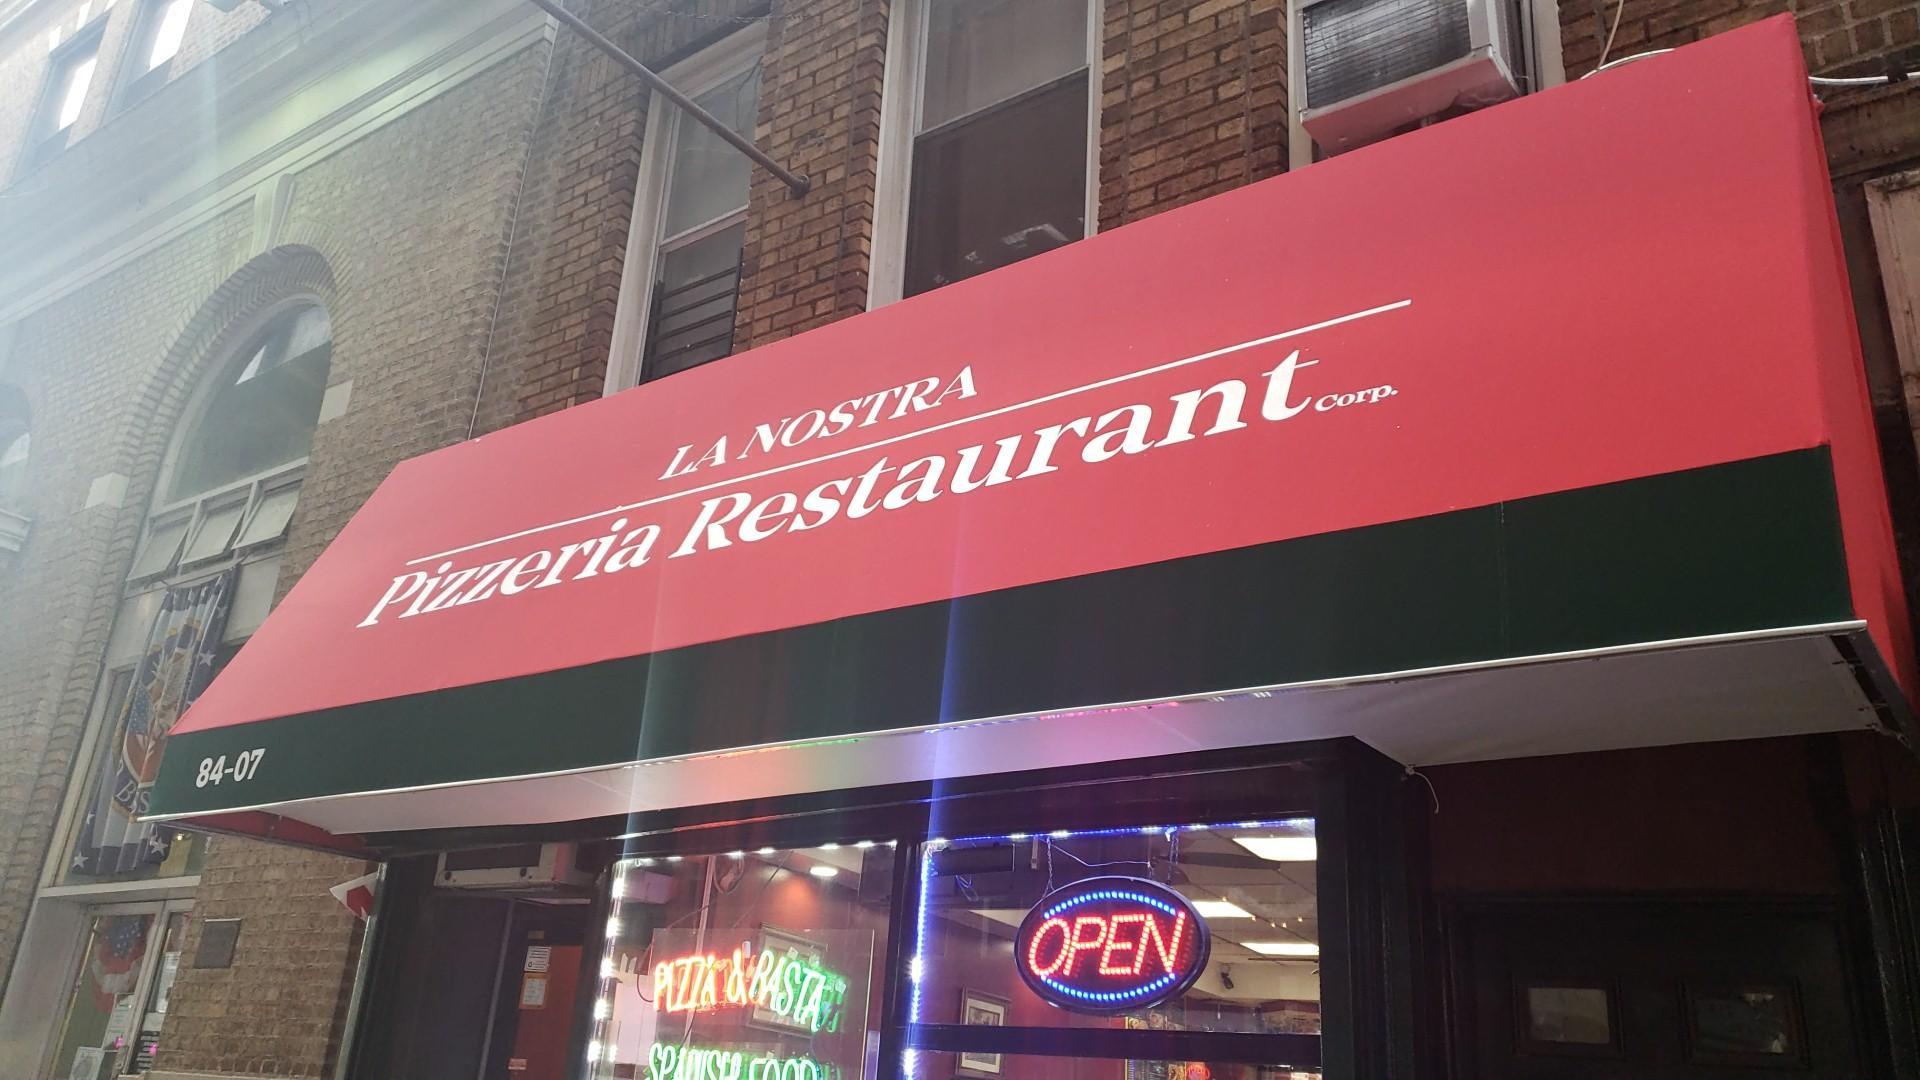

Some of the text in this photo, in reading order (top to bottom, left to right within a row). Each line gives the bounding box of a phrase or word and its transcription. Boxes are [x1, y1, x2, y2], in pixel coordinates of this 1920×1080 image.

[658, 366, 978, 480] LA NOSTRA
[356, 350, 1398, 629] Pizzeria Restaurant Corp.
[194, 747, 266, 789] 84-07
[1028, 910, 1186, 978] OPEN
[652, 948, 827, 1033] PIZZA & PASTA
